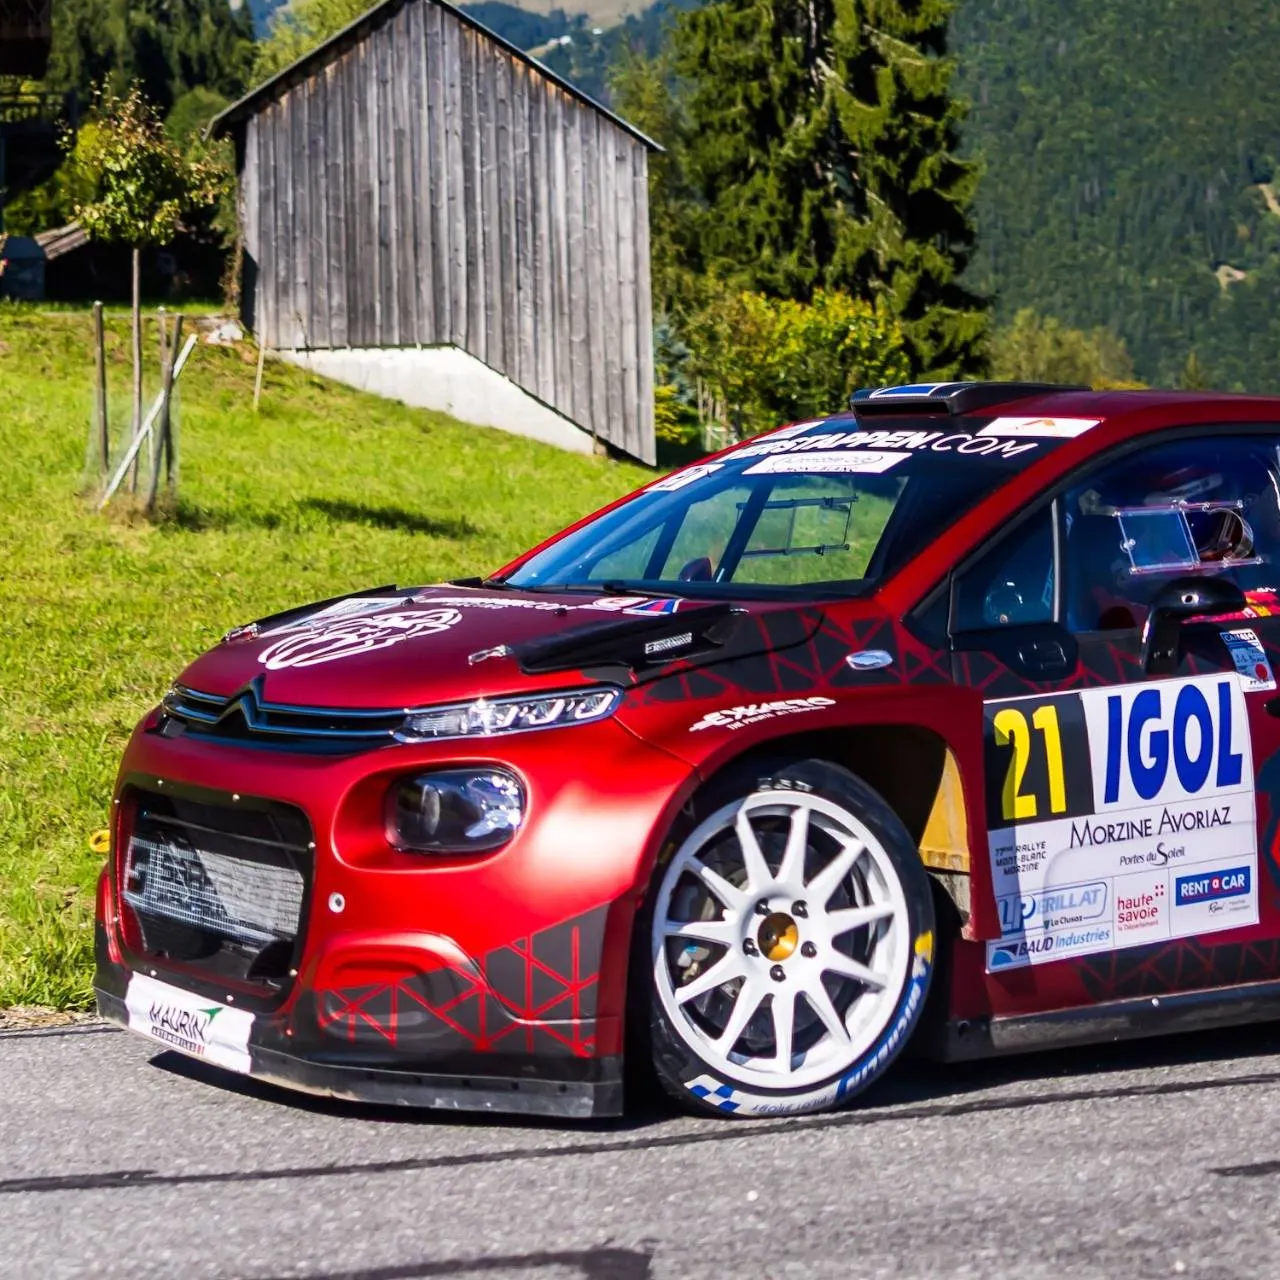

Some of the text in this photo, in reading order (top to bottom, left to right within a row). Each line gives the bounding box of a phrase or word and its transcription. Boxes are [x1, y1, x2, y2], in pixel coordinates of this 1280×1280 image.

[1104, 681, 1243, 805] IGOL
[994, 705, 1067, 821] 21
[1070, 807, 1232, 849] MORZINE AVORIAZ
[1120, 842, 1185, 866] Portes du Soleil
[1181, 880, 1209, 897] RENT
[1221, 874, 1245, 890] CAR
[1117, 894, 1153, 911] haute
[1118, 907, 1158, 923] savoie
[1019, 929, 1110, 955] BAUD Industries
[150, 1000, 207, 1041] MAURIN
